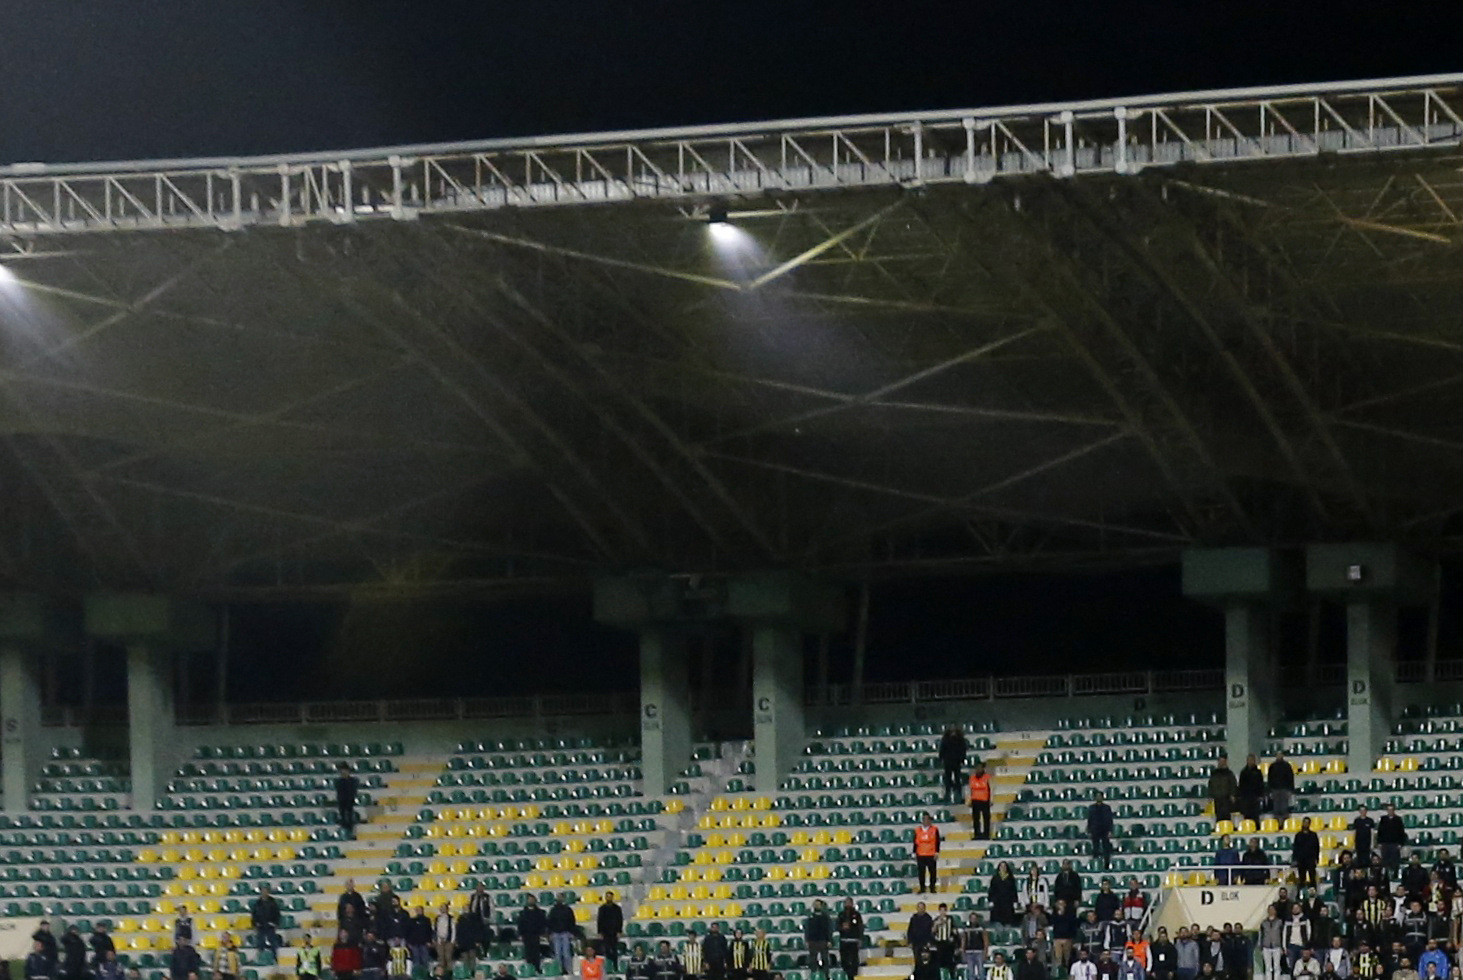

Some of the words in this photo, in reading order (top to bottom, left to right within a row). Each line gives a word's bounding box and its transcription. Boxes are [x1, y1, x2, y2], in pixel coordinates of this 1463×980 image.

[1231, 684, 1244, 698] D
[1352, 680, 1366, 695] D
[1201, 890, 1214, 905] D
